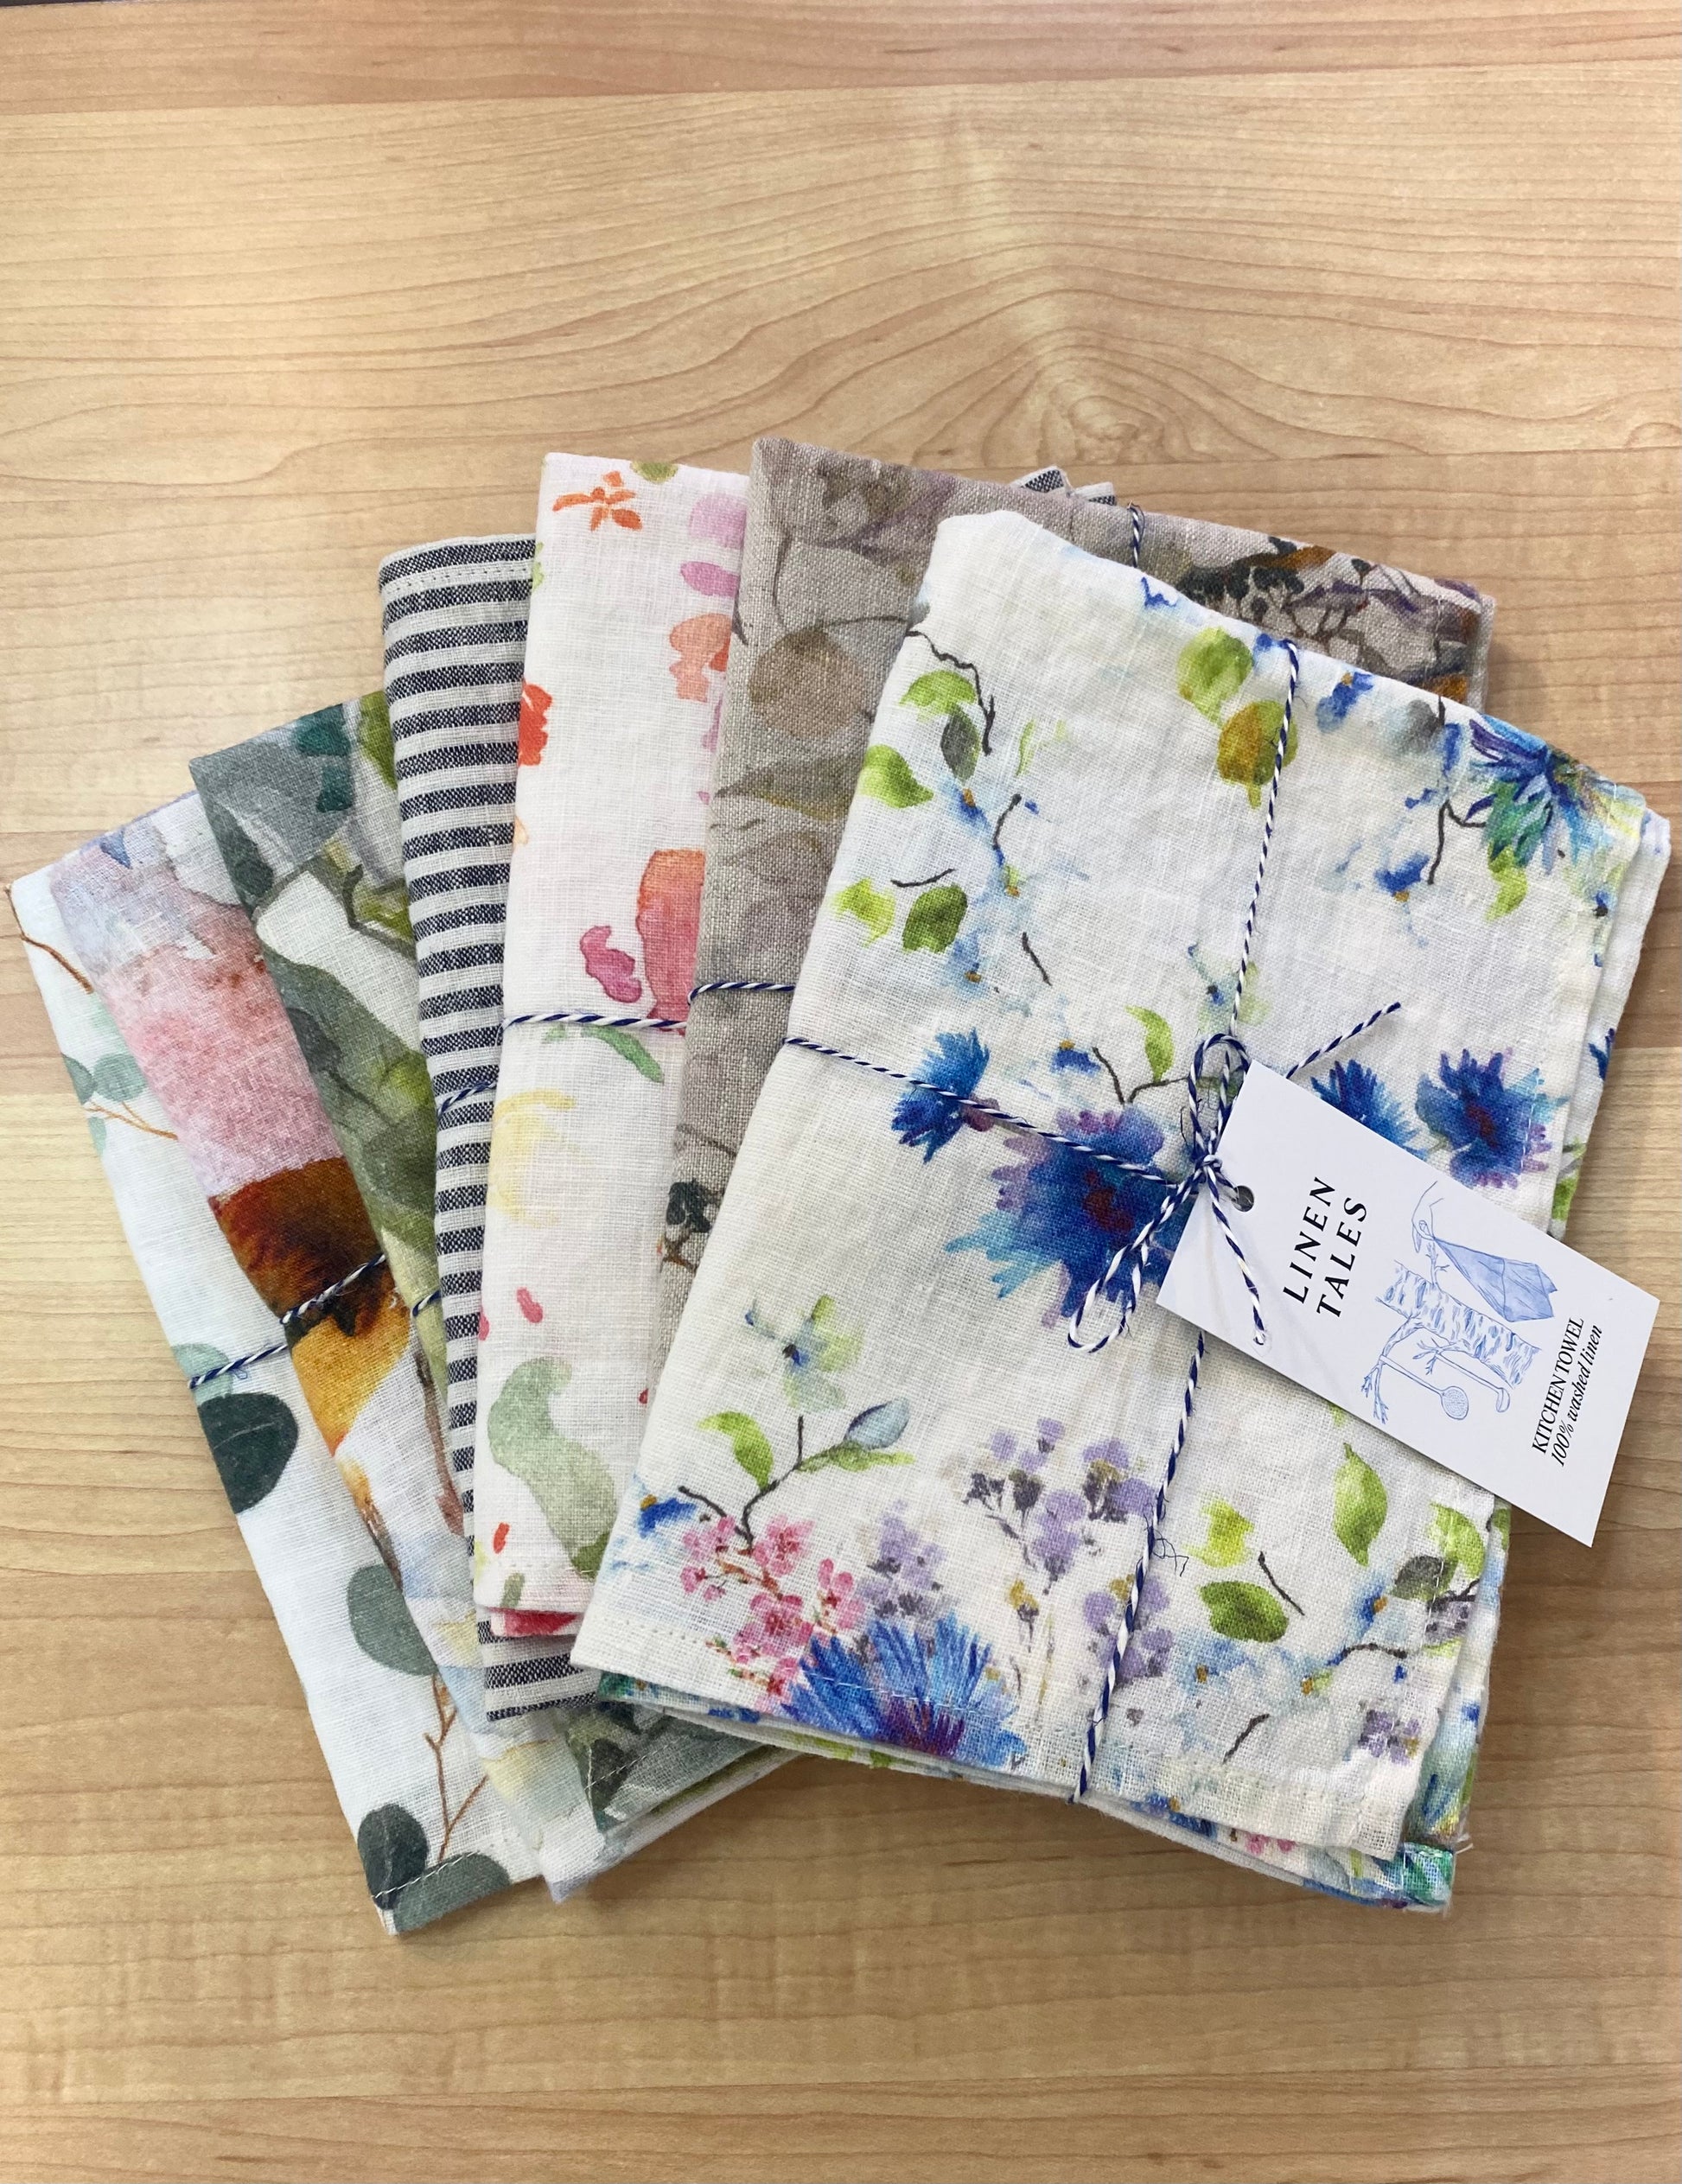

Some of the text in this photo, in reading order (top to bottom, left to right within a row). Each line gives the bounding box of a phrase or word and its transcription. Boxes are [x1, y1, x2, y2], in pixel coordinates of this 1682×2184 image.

[1283, 1176, 1336, 1304] LINEN
[1316, 1196, 1367, 1318] TALES
[1532, 1317, 1584, 1455] KITCHEN TOWEL
[1551, 1325, 1602, 1467] 100% washed linen
